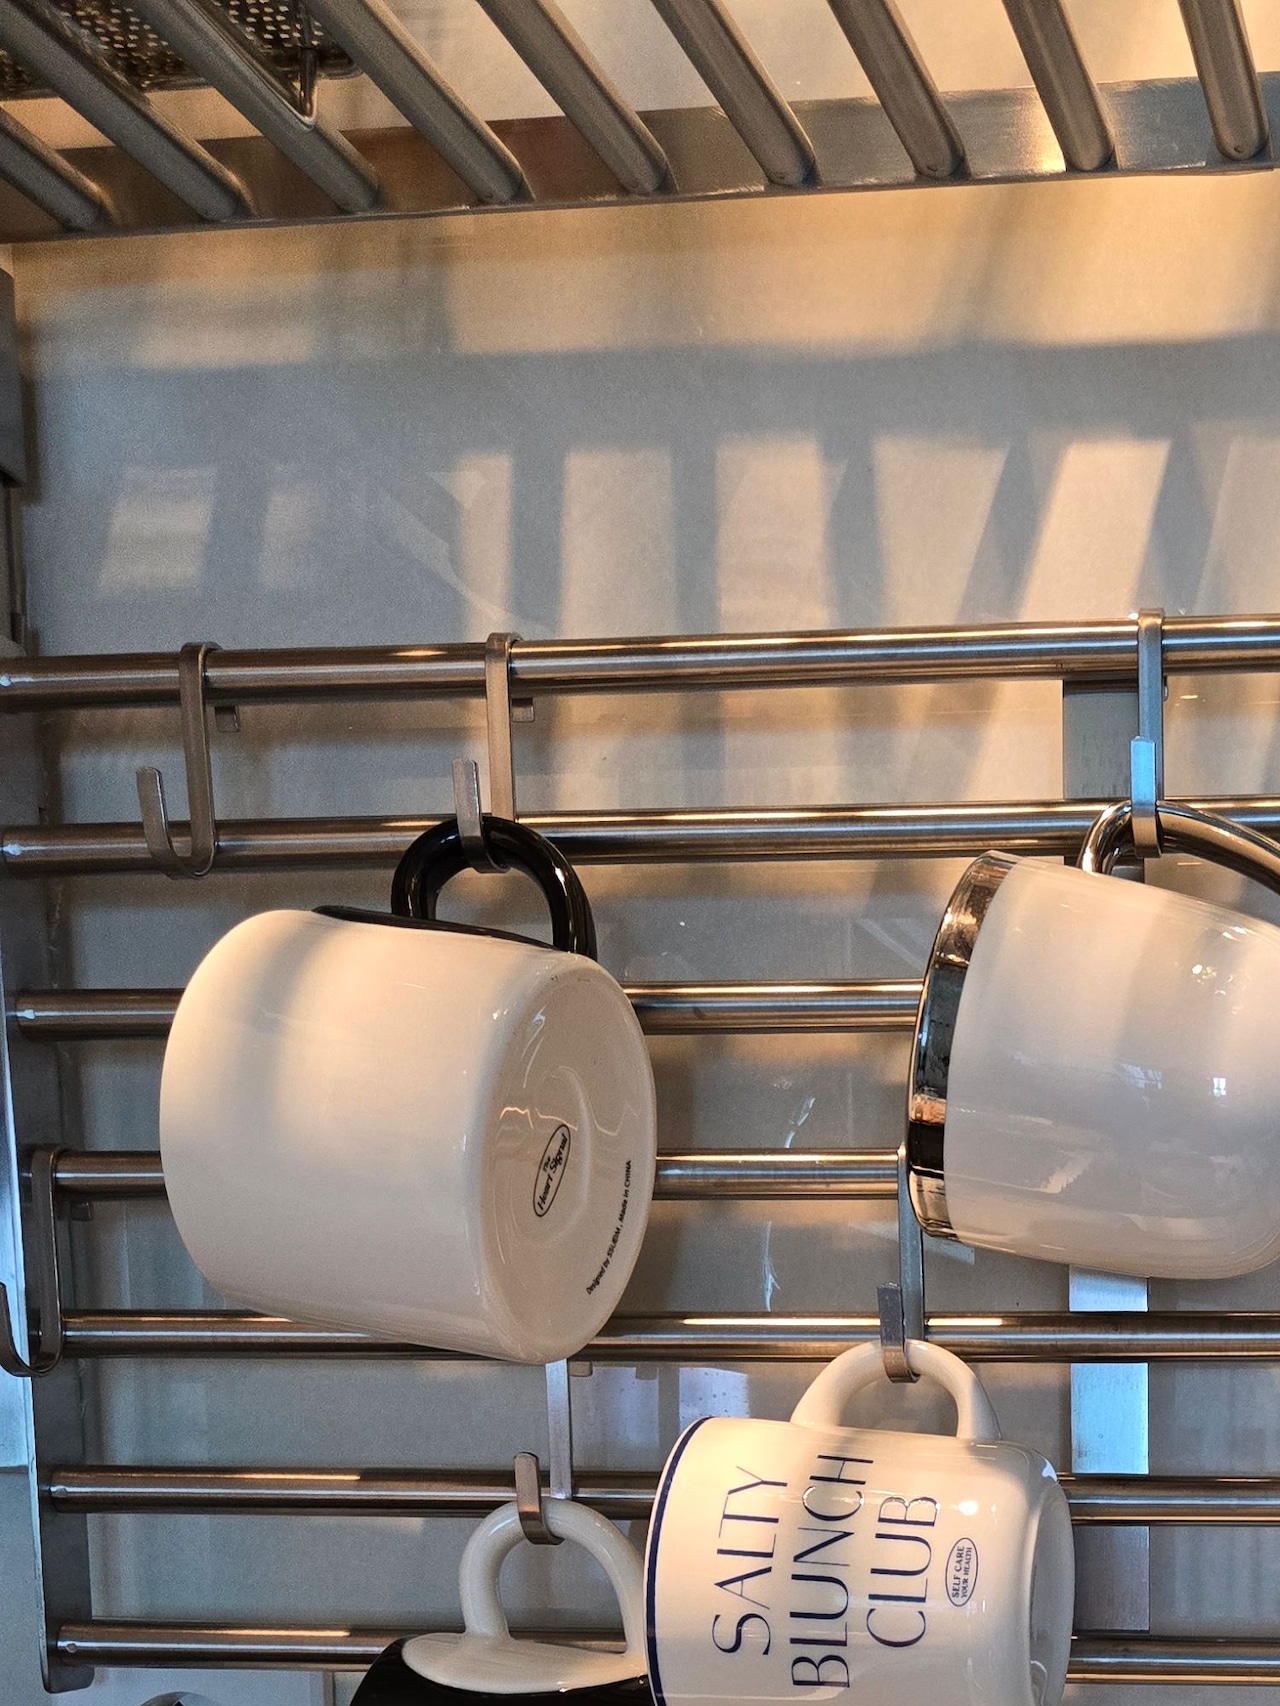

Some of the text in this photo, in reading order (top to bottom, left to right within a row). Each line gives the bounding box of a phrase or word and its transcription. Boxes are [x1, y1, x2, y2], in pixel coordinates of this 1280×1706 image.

[537, 1132, 568, 1211] Heart Signal
[586, 1265, 606, 1295] Designed
[618, 1199, 628, 1222] Made
[624, 1160, 632, 1188] CHINA
[712, 1465, 789, 1656] SALTY
[789, 1454, 874, 1688] BLUNCH
[866, 1496, 941, 1649] CLUB
[951, 1545, 965, 1599] SELF CARE
[960, 1546, 973, 1598] YOUR HEALTH
